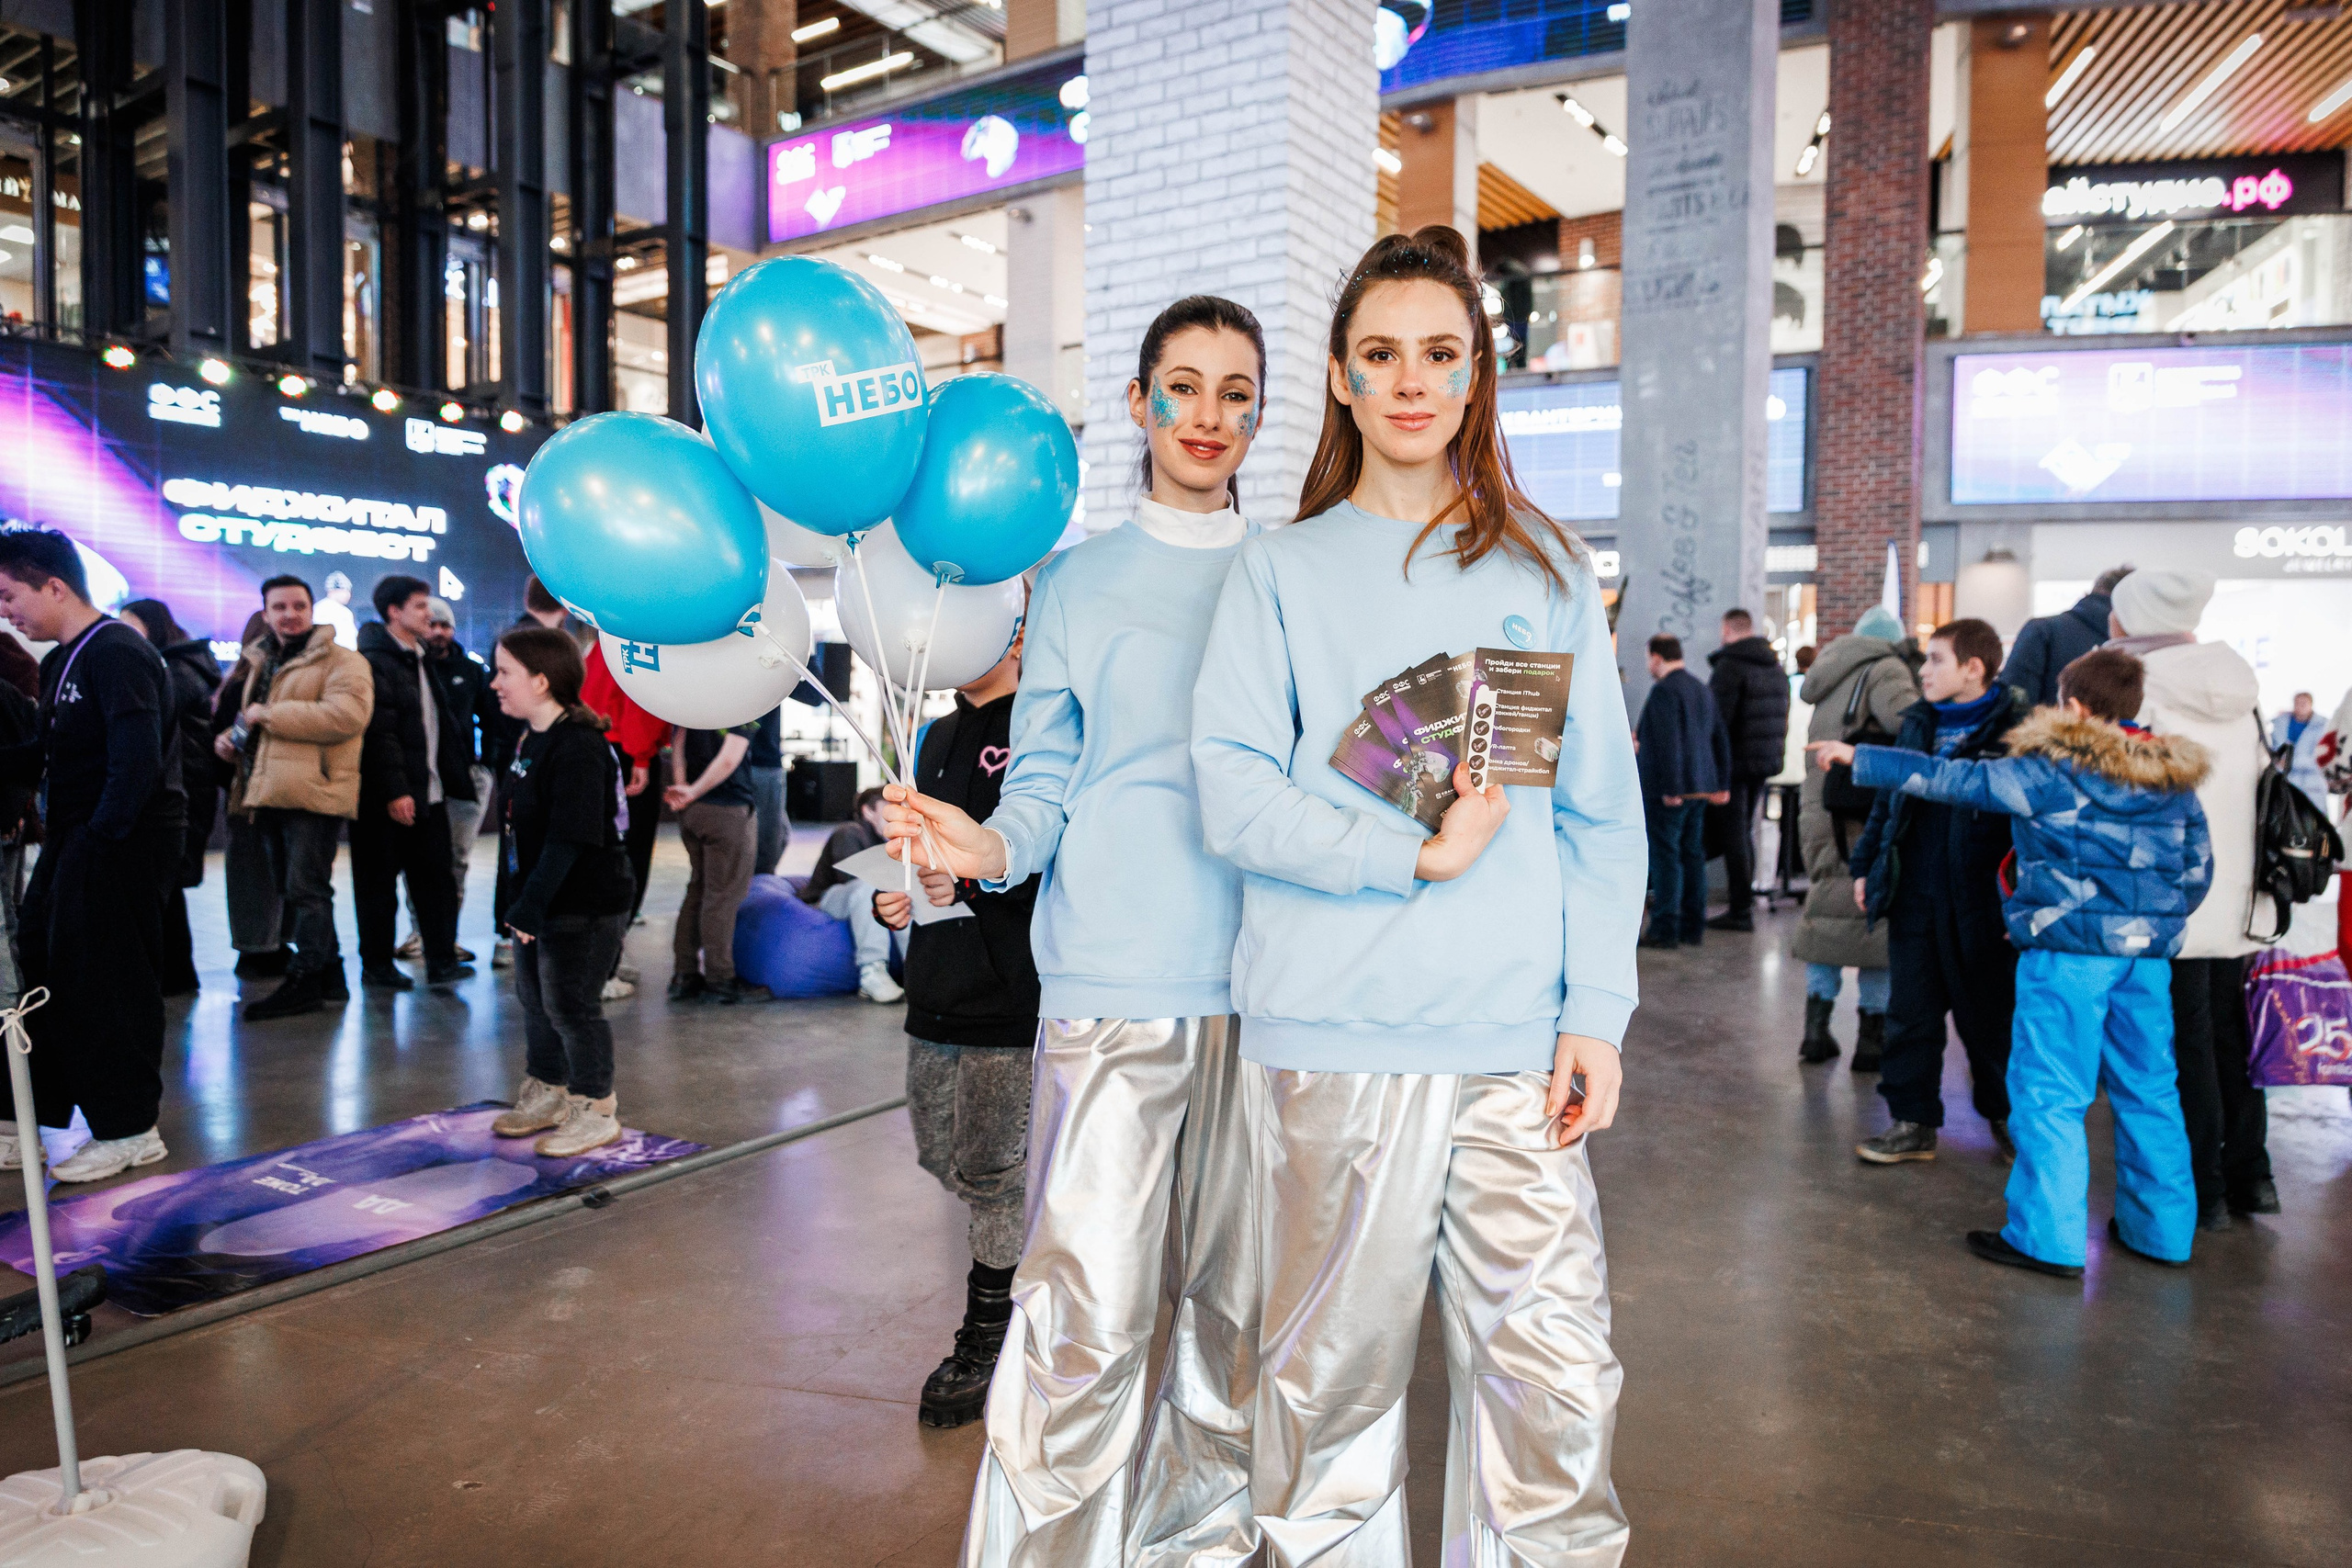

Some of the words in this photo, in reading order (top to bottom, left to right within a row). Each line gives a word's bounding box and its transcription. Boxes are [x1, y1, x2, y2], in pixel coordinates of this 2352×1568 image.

[801, 364, 831, 378] ТРК
[823, 369, 919, 418] НЕБО
[164, 479, 447, 533] ФИДЖИТАЛ
[1453, 660, 1473, 671] НЕБО
[1485, 659, 1514, 667] Пройди
[2296, 1013, 2352, 1060] 25
